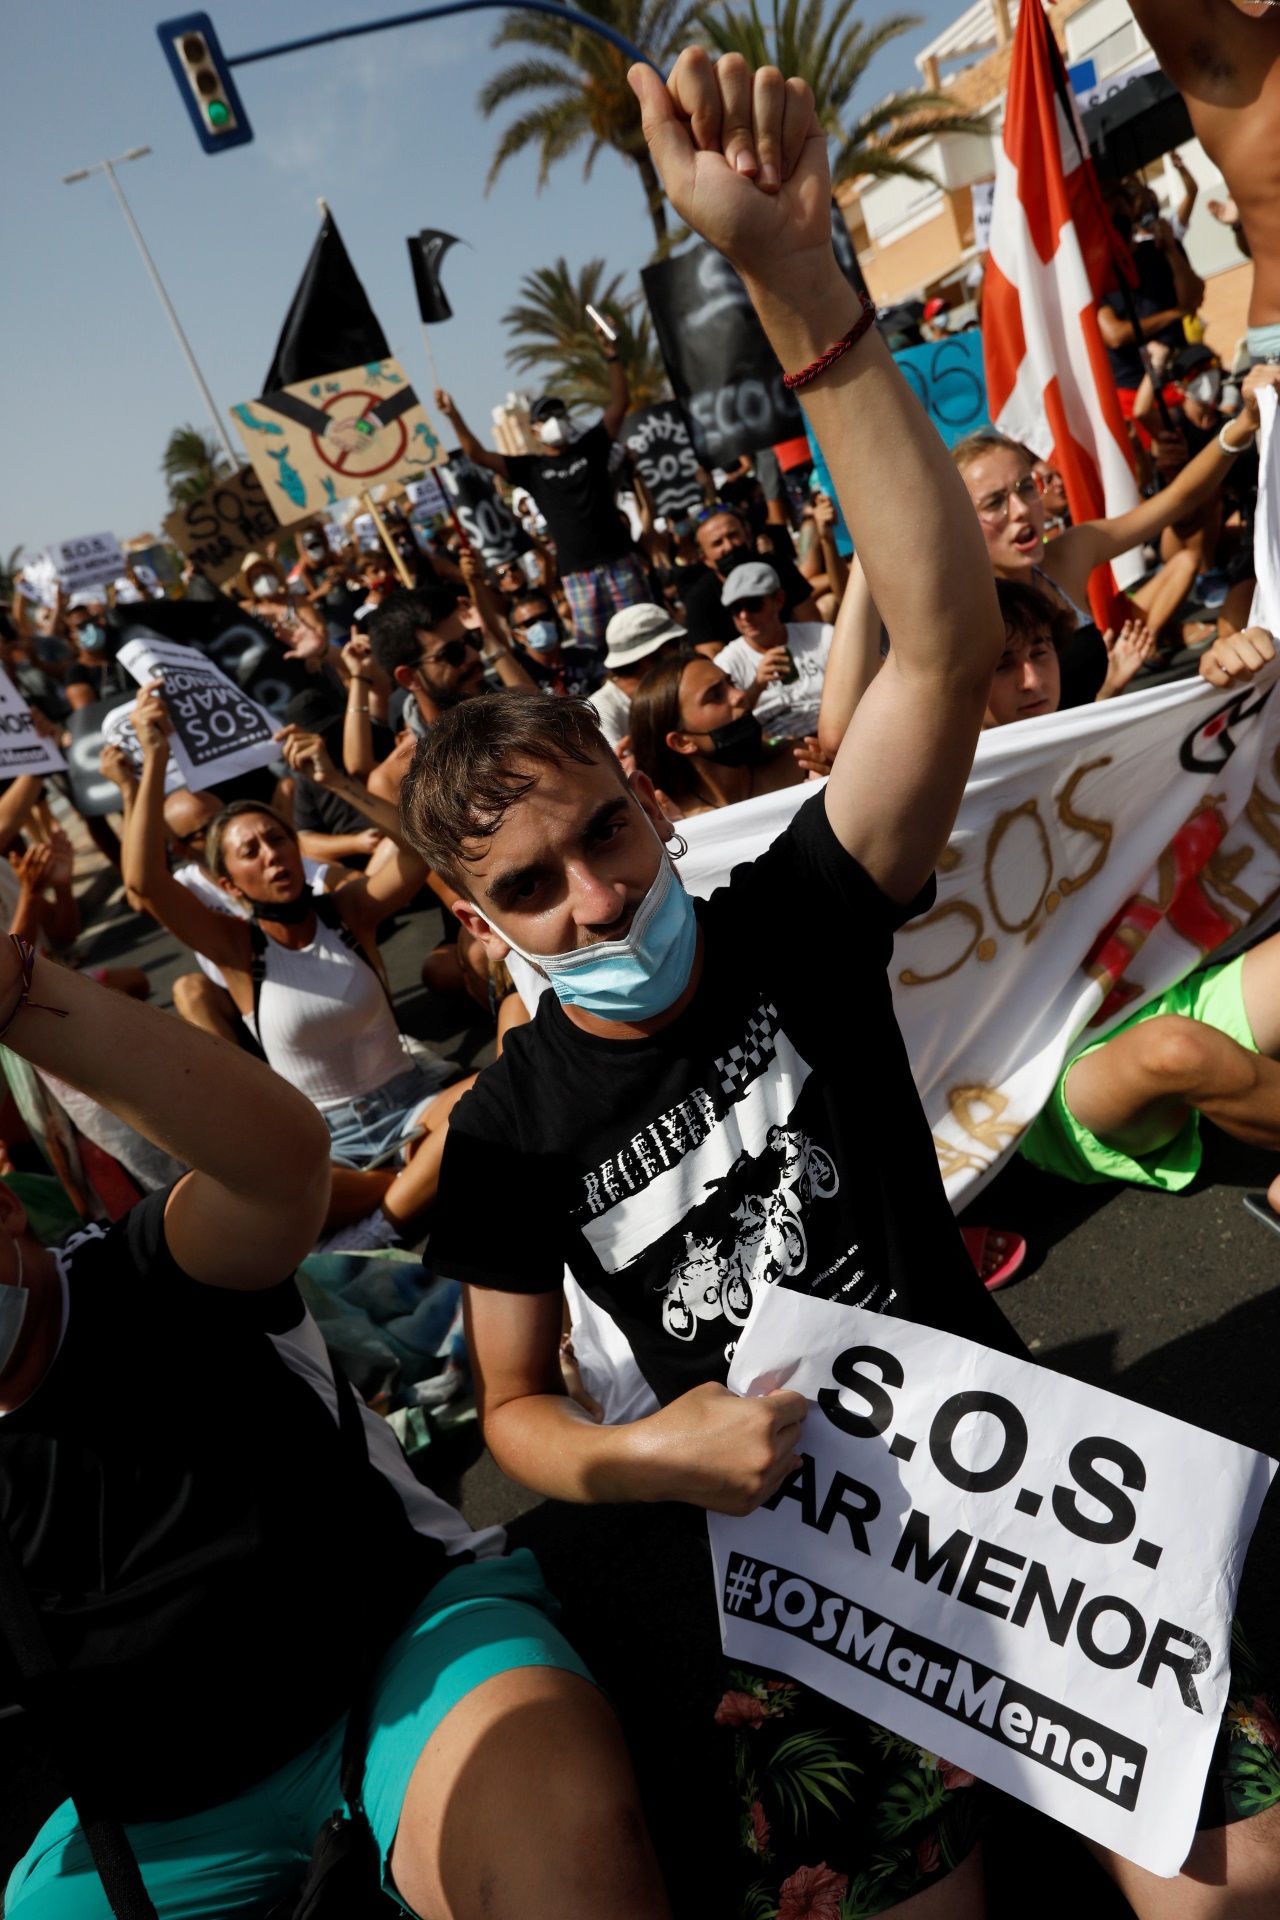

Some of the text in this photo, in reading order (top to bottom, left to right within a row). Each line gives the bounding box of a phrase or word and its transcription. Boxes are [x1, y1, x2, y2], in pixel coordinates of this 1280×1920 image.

[637, 447, 700, 488] SOS
[173, 687, 242, 718] MAR
[185, 702, 259, 748] SOS
[847, 1243, 859, 1256] are
[817, 1345, 1164, 1570] S.O.S.
[761, 1453, 1213, 1716] AR MENOR
[725, 1559, 1137, 1797] #SOSMarMenor
